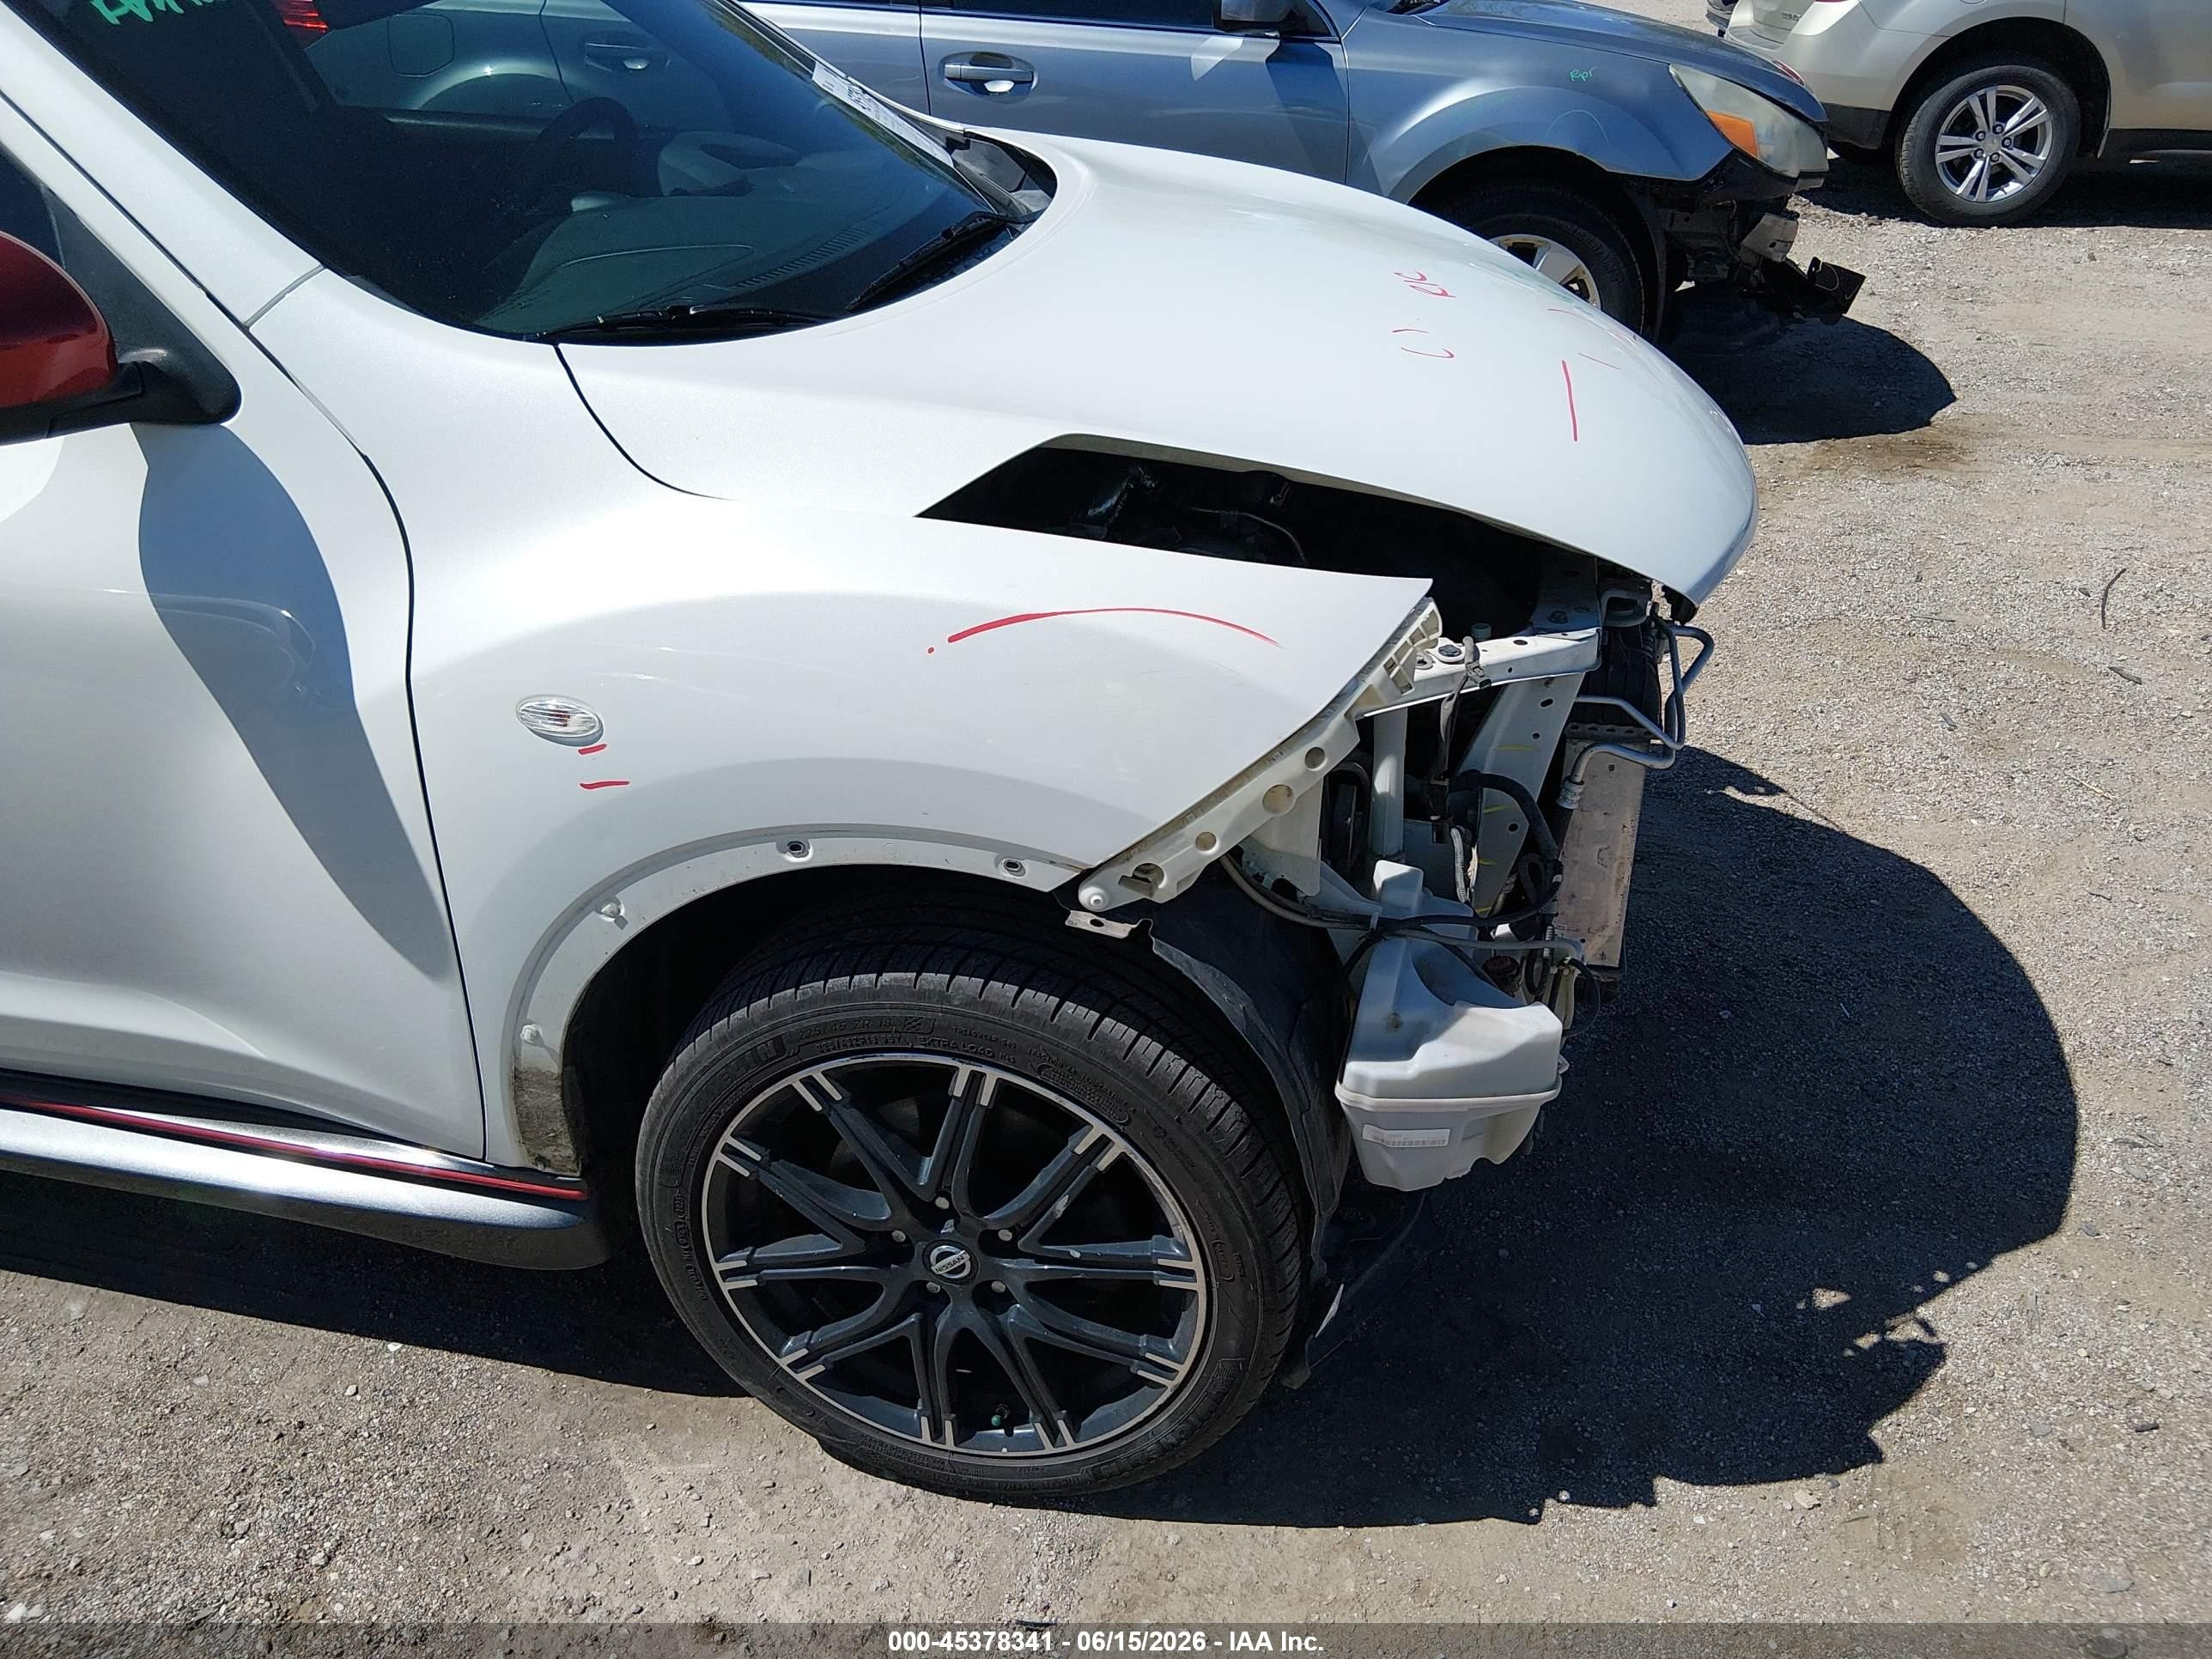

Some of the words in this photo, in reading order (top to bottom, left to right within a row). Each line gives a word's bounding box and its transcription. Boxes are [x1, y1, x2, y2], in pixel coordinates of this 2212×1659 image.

[848, 1017, 871, 1030] ZR
[876, 1016, 893, 1028] 18
[961, 1042, 994, 1058] LOAD
[934, 1254, 965, 1273] NISSAN
